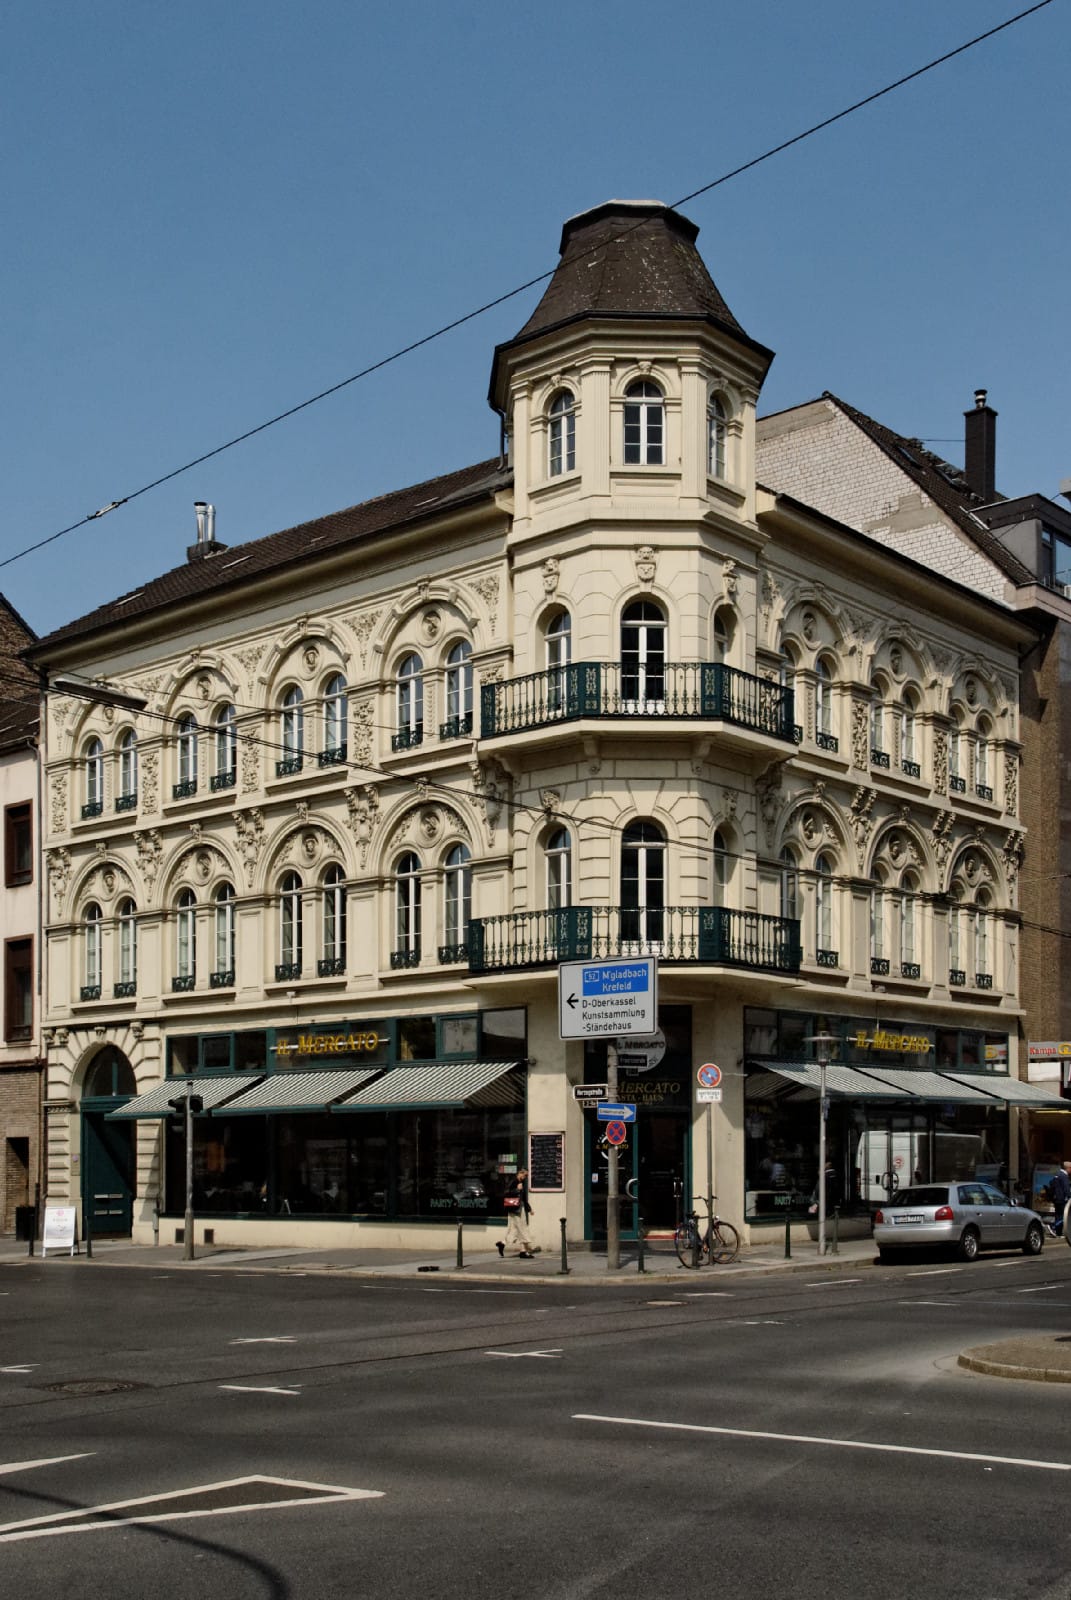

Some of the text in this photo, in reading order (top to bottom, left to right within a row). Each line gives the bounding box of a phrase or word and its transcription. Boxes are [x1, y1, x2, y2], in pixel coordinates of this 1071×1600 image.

[602, 969, 647, 980] M'gladbach
[602, 981, 632, 992] Krefeld
[582, 996, 636, 1008] D-Oberkassel
[582, 1009, 645, 1020] Kunstsammlung
[582, 1022, 632, 1032] -Ständehaus
[276, 1031, 379, 1055] IL MERCATO
[625, 1041, 665, 1049] MERCATO
